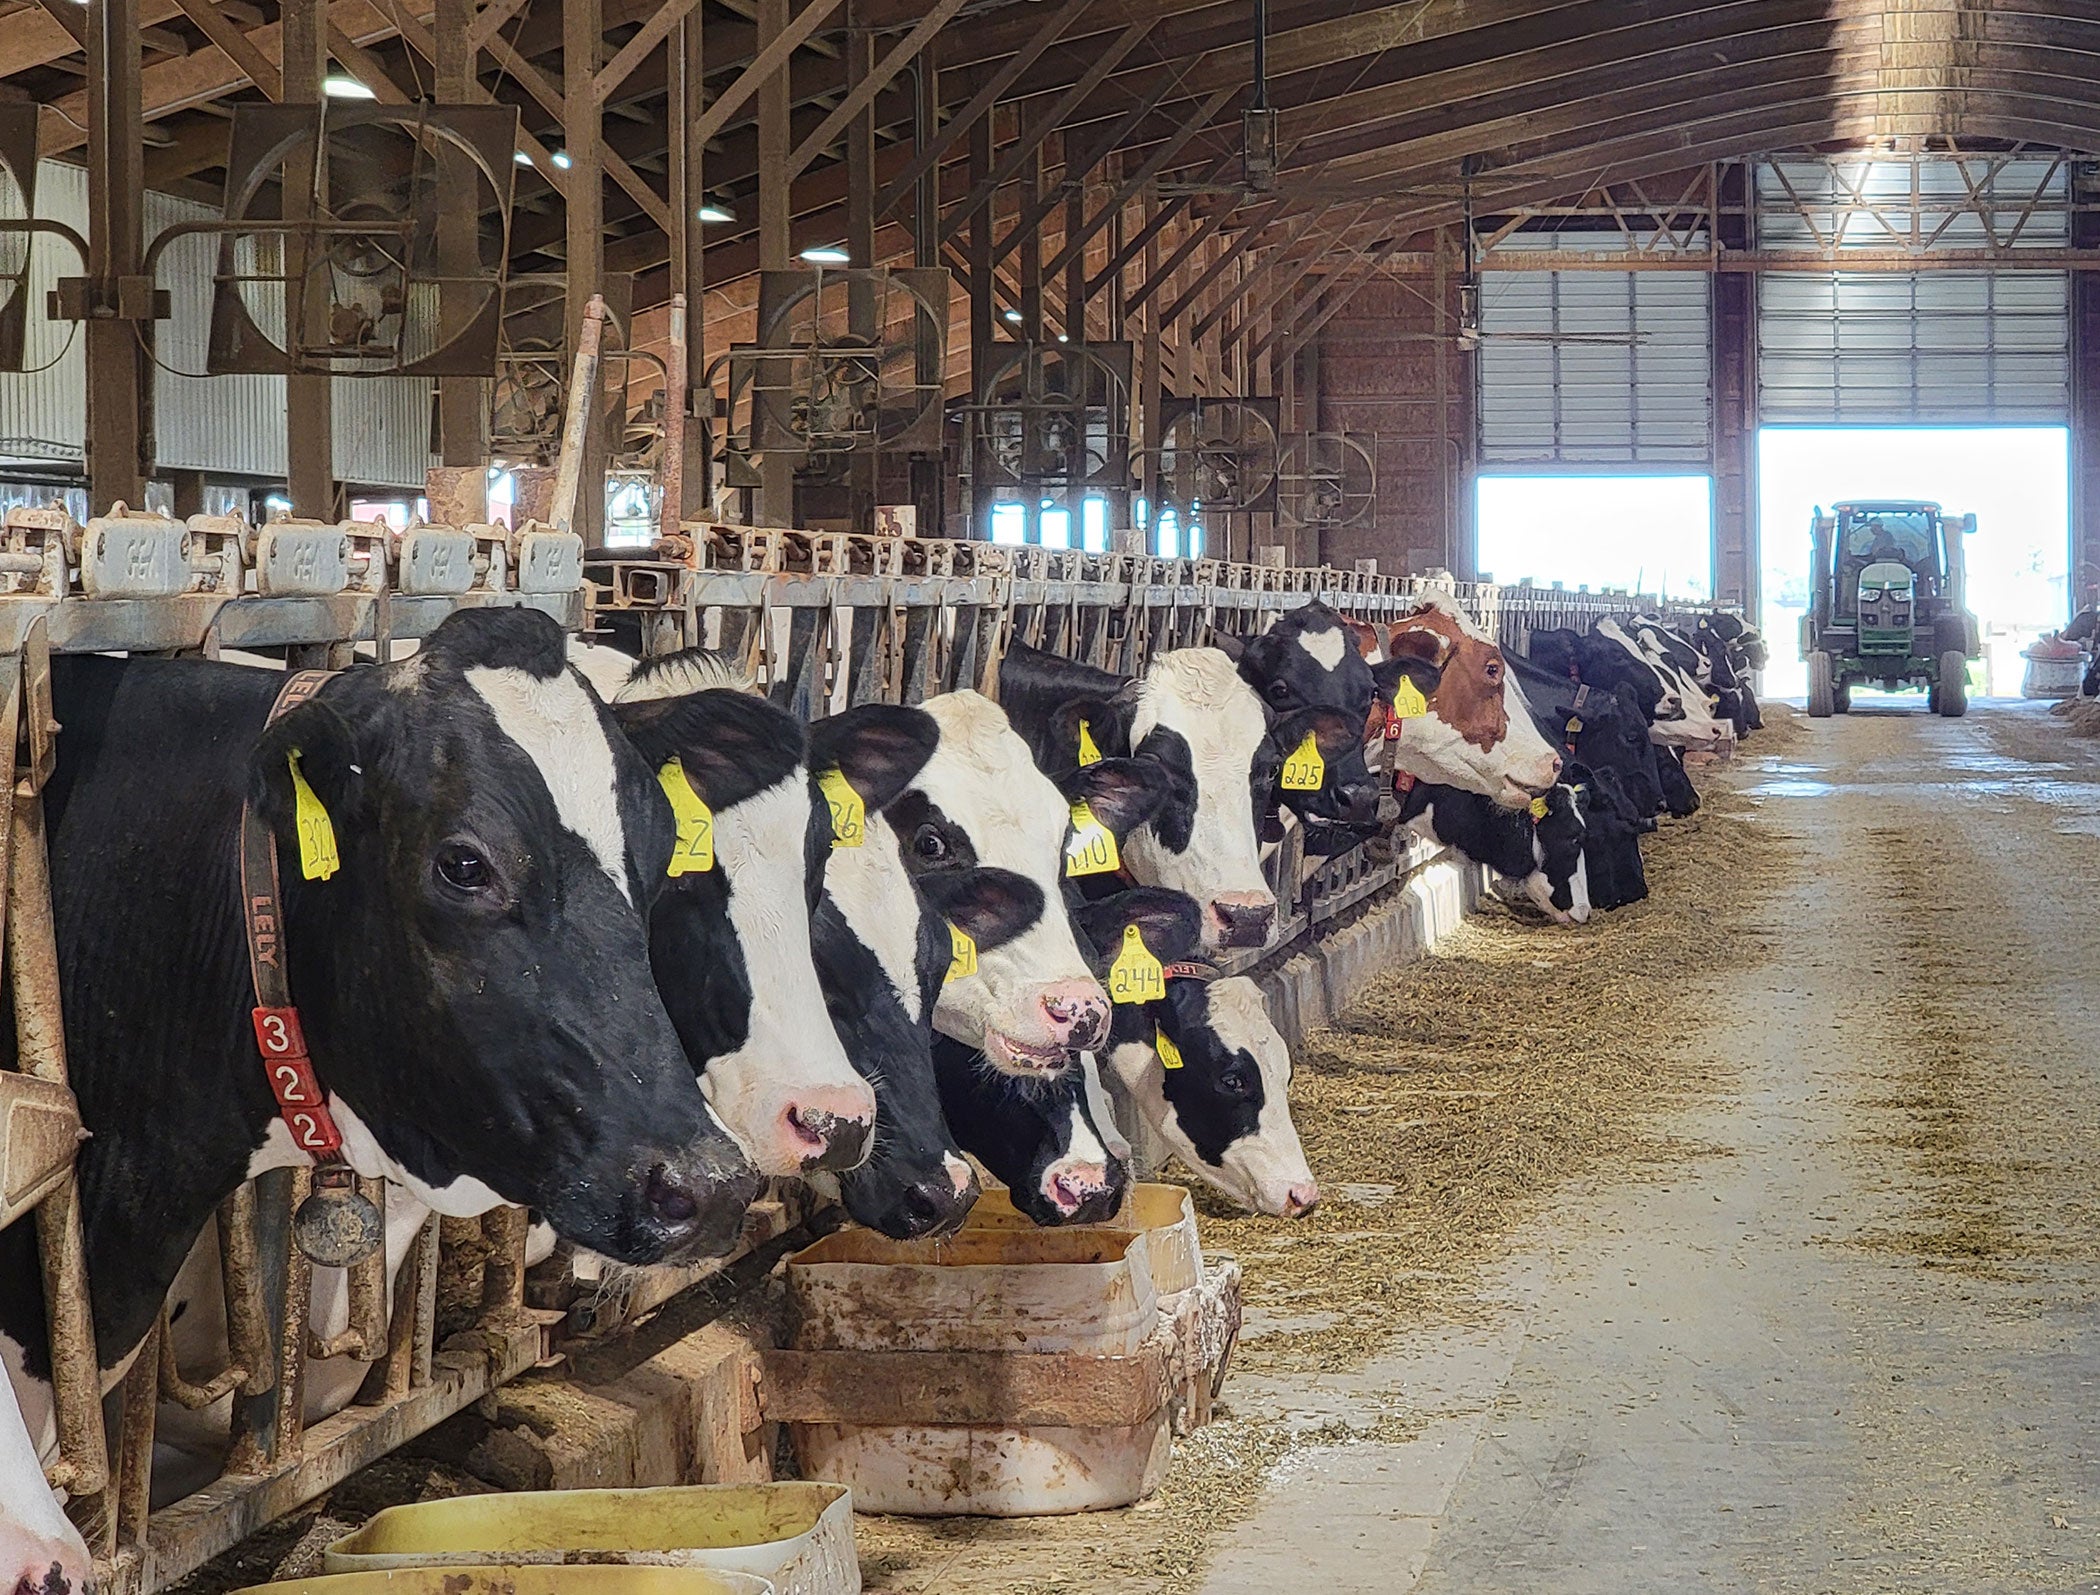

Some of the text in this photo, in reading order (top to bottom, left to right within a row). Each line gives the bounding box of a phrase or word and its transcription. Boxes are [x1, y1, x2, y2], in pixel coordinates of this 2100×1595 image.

[1398, 696, 1421, 715] 92
[1285, 763, 1321, 785] 225
[251, 896, 279, 969] LELY
[1116, 967, 1160, 993] 244
